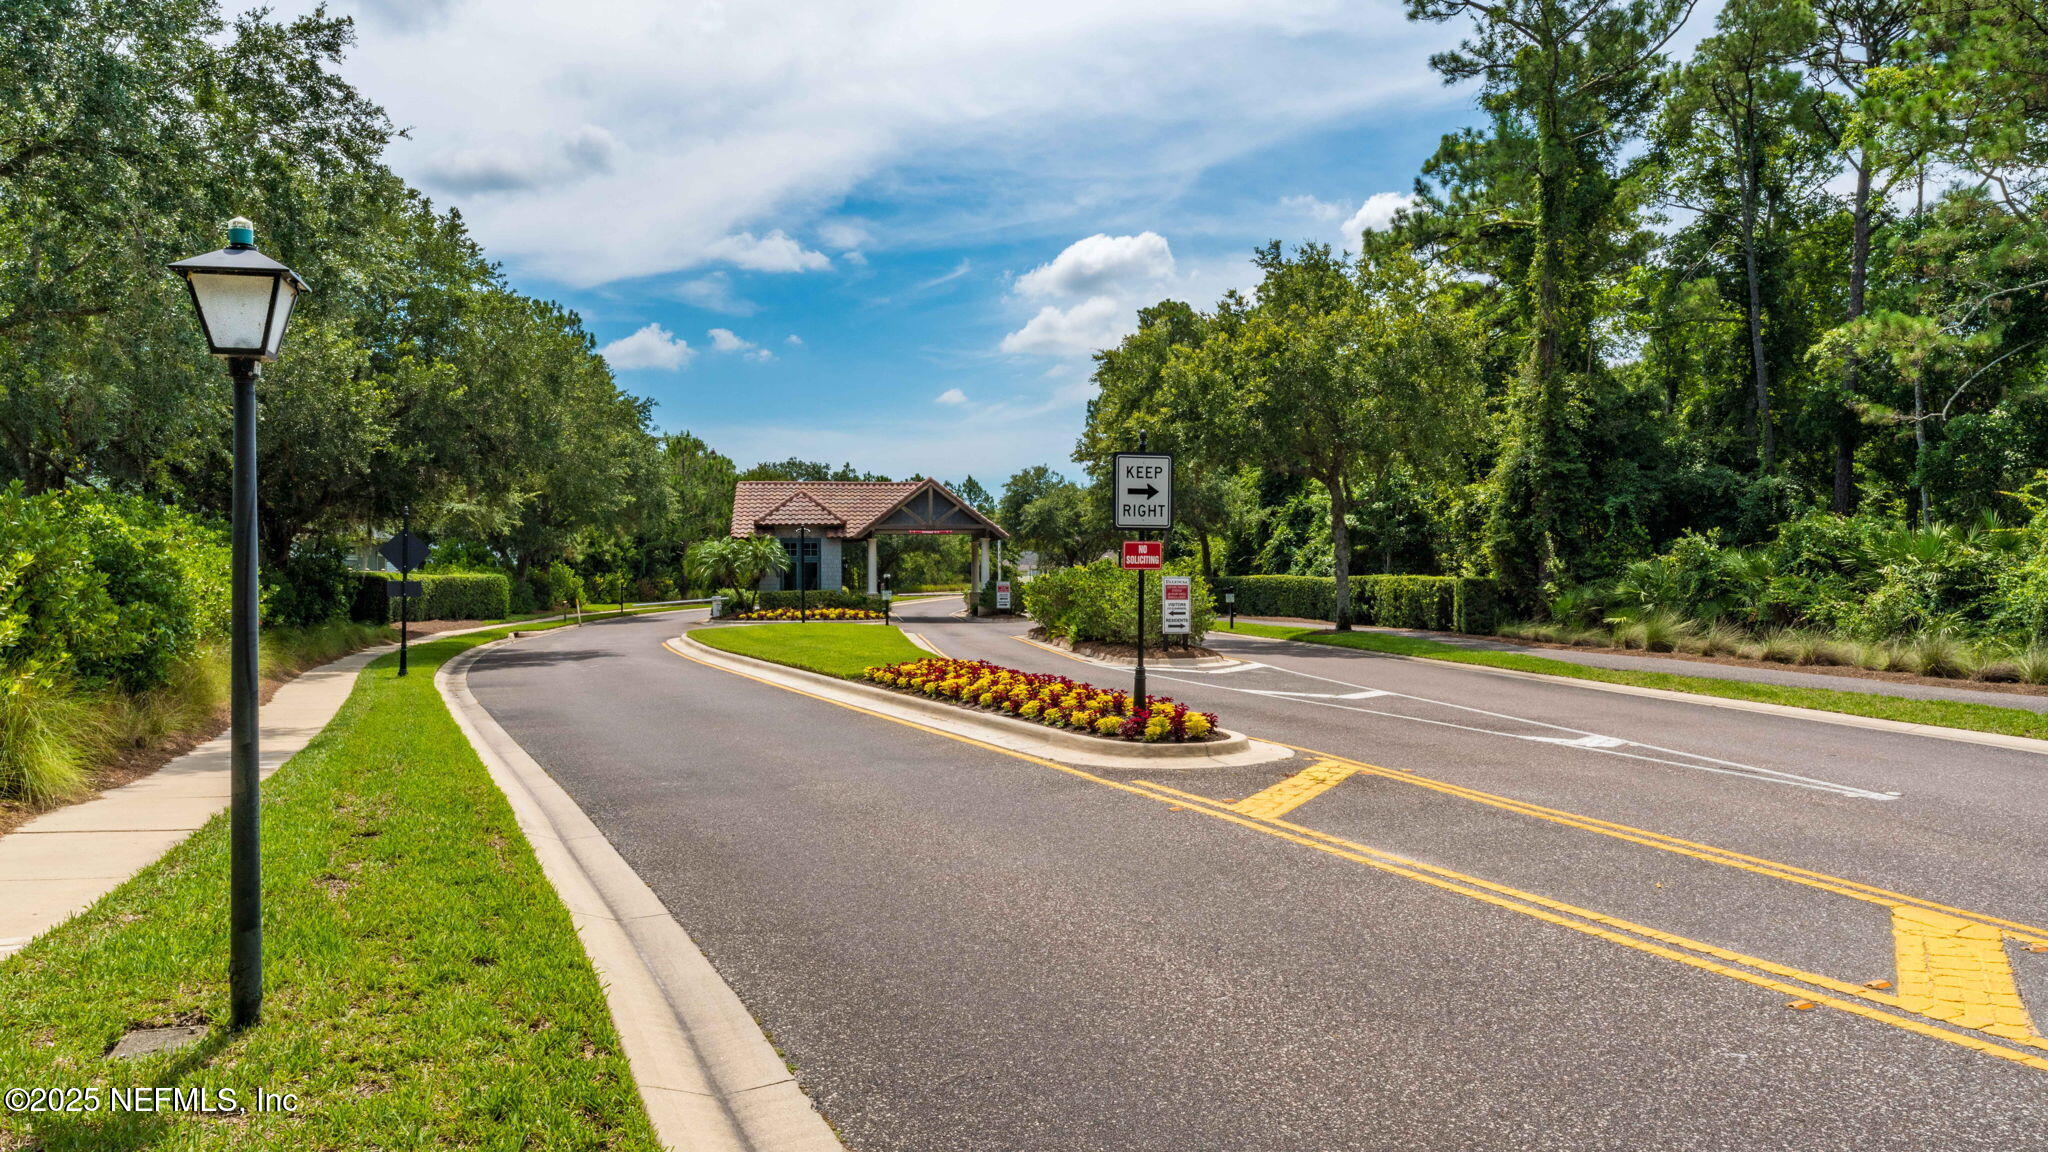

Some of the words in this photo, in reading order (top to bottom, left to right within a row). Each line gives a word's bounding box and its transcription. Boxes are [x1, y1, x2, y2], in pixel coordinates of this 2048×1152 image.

[1126, 466, 1163, 479] KEEP
[1123, 504, 1166, 517] RIGHT
[1138, 545, 1148, 554] NO
[1126, 555, 1160, 565] SOLICITING
